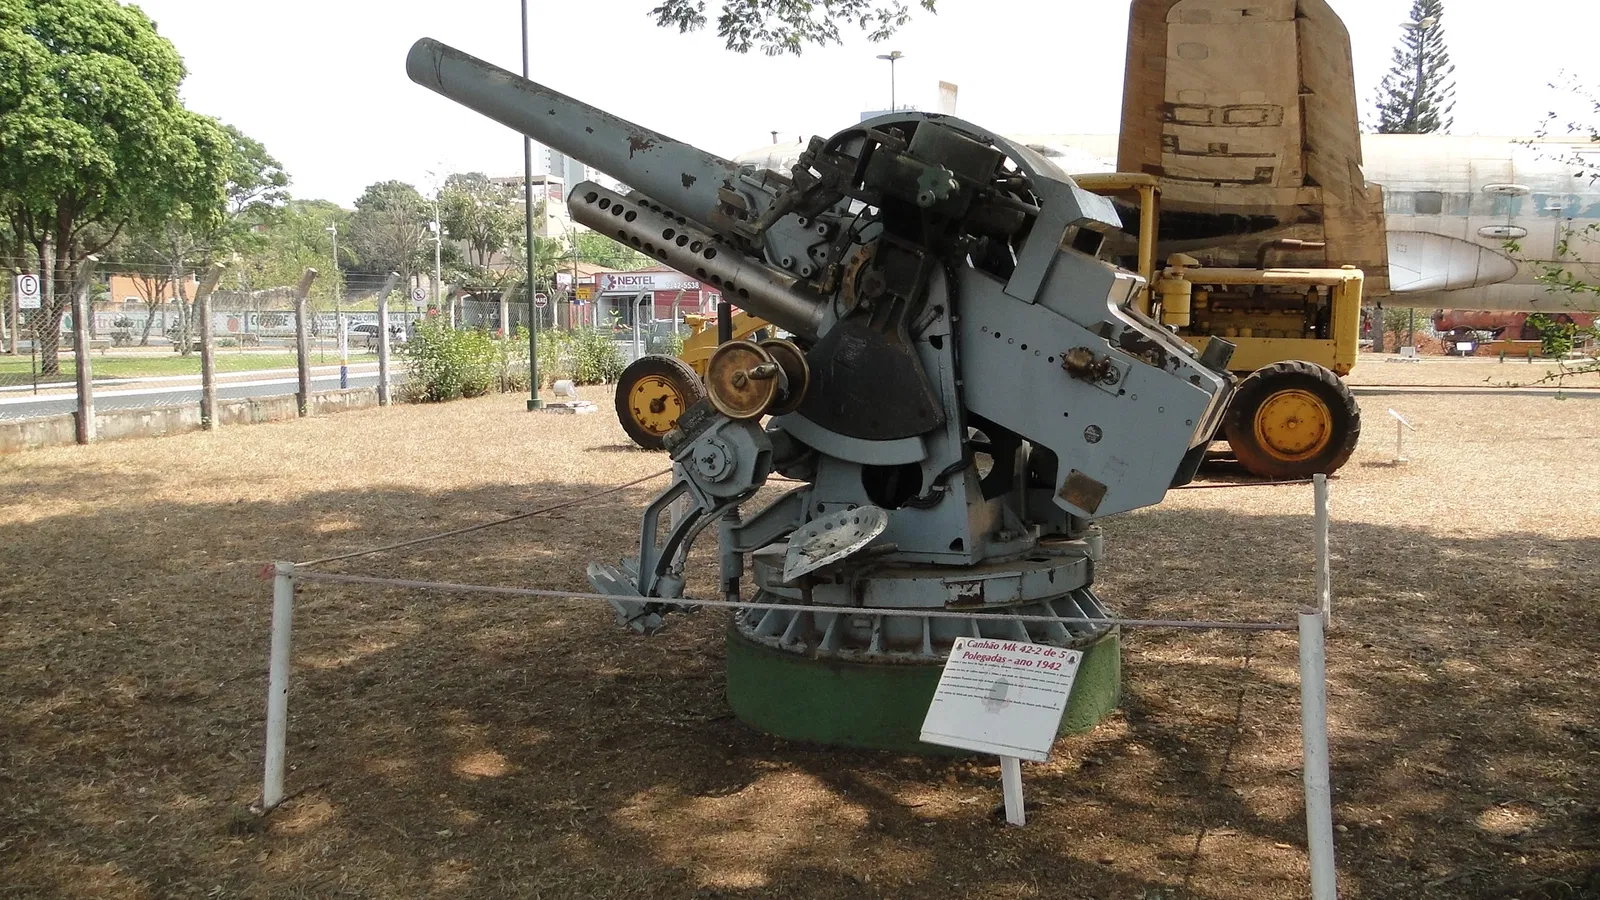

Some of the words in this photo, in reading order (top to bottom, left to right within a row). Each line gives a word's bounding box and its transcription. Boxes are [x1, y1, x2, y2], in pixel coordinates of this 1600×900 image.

[25, 278, 32, 292] E
[617, 276, 655, 285] NEXTEL
[966, 639, 1000, 651] Canhão
[1001, 642, 1017, 652] Mk
[1019, 645, 1042, 655] 42-2
[1043, 648, 1057, 658] de
[1058, 650, 1068, 660] 5
[962, 651, 1007, 664] Polegadas
[1013, 658, 1033, 667] ano
[1036, 659, 1062, 671] 1942
